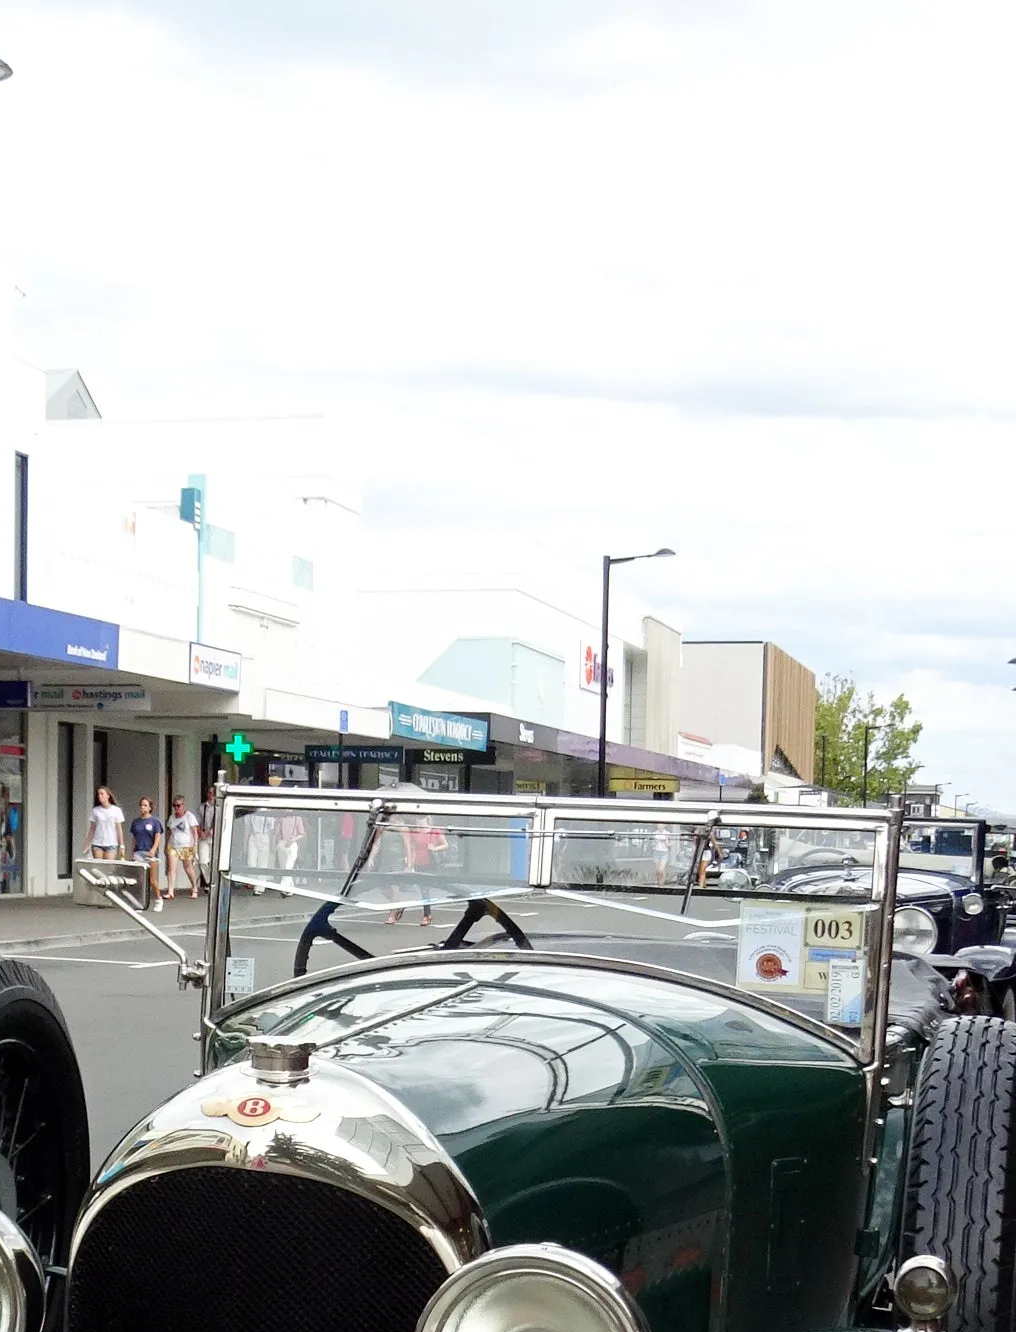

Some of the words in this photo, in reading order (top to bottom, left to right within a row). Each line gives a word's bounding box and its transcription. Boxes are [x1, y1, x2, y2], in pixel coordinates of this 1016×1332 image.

[200, 659, 222, 680] napier
[40, 689, 64, 699] mail
[82, 687, 122, 701] hastings
[124, 689, 146, 699] mail
[423, 749, 464, 763] Stevens
[634, 782, 666, 791] Farmers
[746, 923, 798, 937] FESTIVAL
[813, 919, 853, 940] 003
[829, 971, 843, 1023] 02/02/2019
